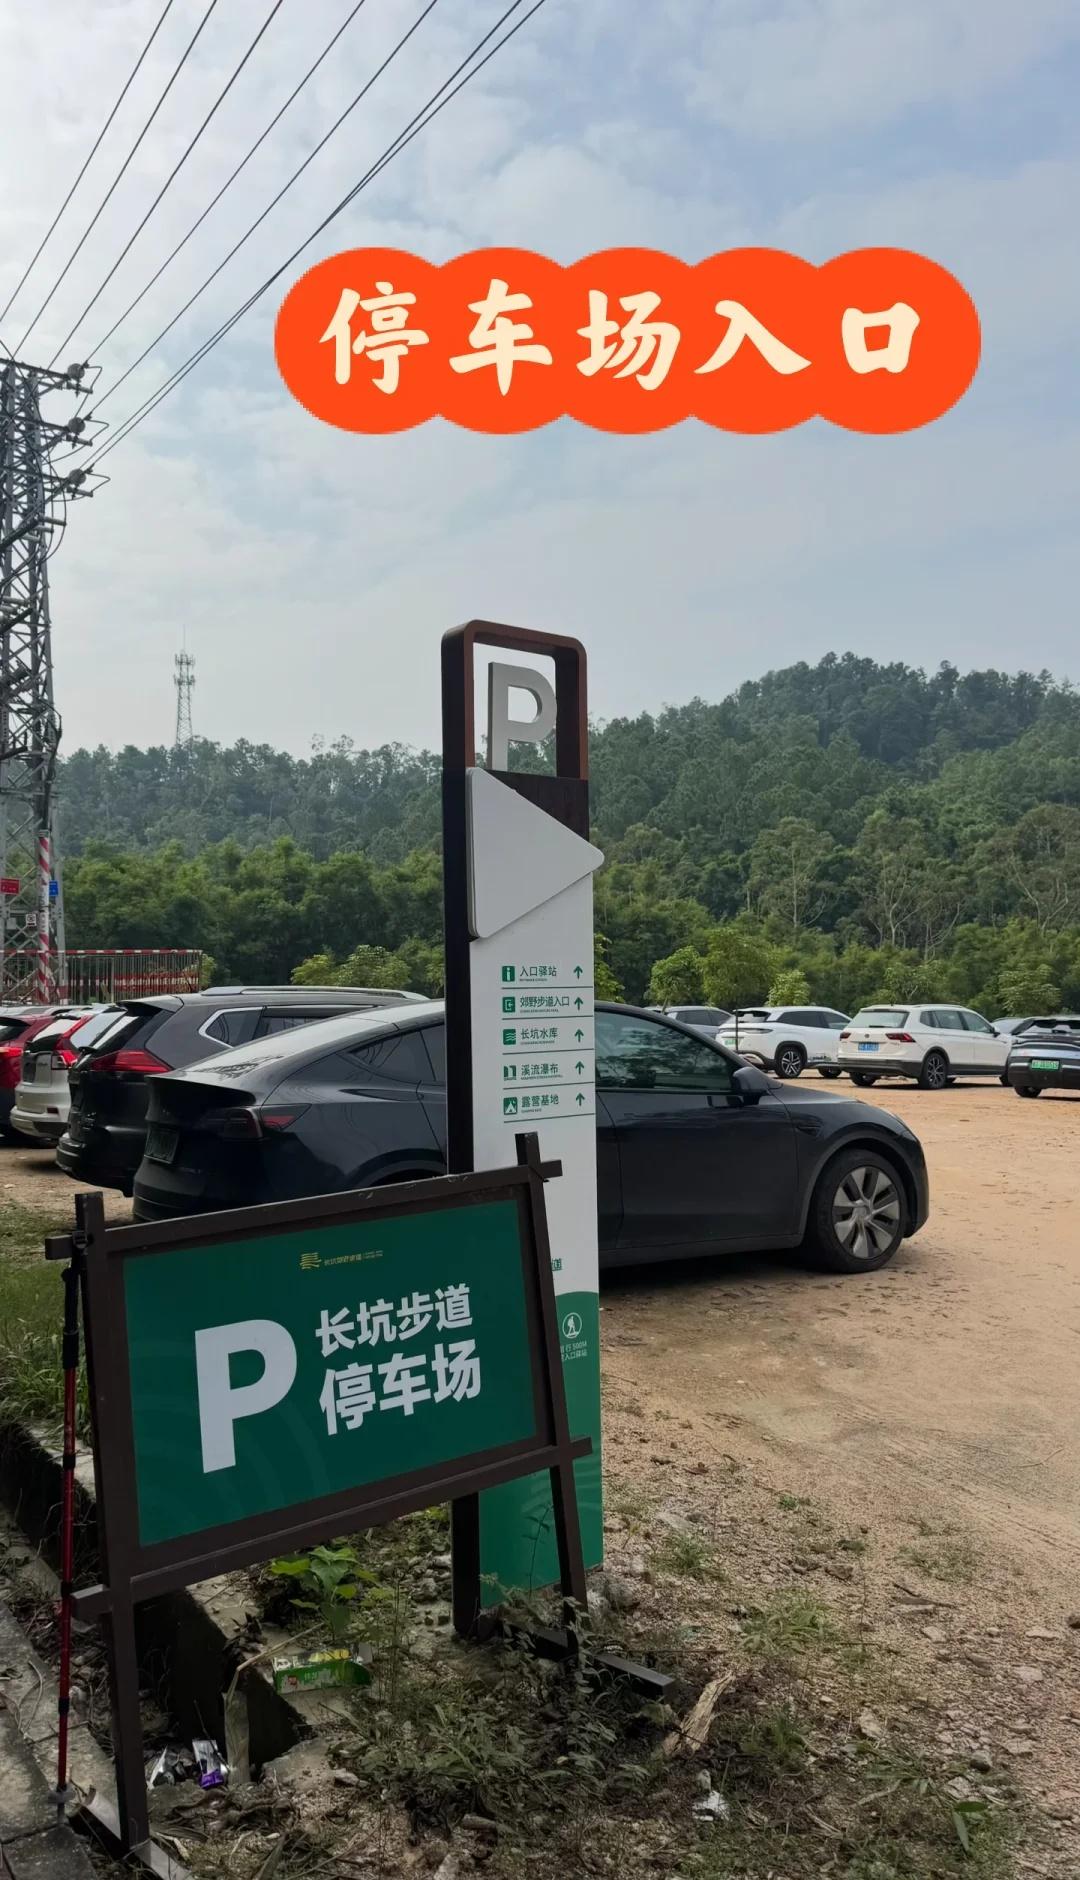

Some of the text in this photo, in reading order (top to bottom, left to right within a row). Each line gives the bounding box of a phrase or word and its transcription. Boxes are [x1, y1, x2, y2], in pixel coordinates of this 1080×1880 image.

[487, 661, 558, 771] P
[519, 965, 557, 977] 入口驿站
[520, 995, 570, 1008] 郊野步道入口
[520, 1027, 559, 1040] 长坑水库
[521, 1063, 559, 1076] 溪流瀑布
[521, 1094, 560, 1108] 露营基地
[315, 1283, 473, 1357] 长坑步道
[319, 1339, 481, 1436] 停车场
[195, 1319, 298, 1474] P
